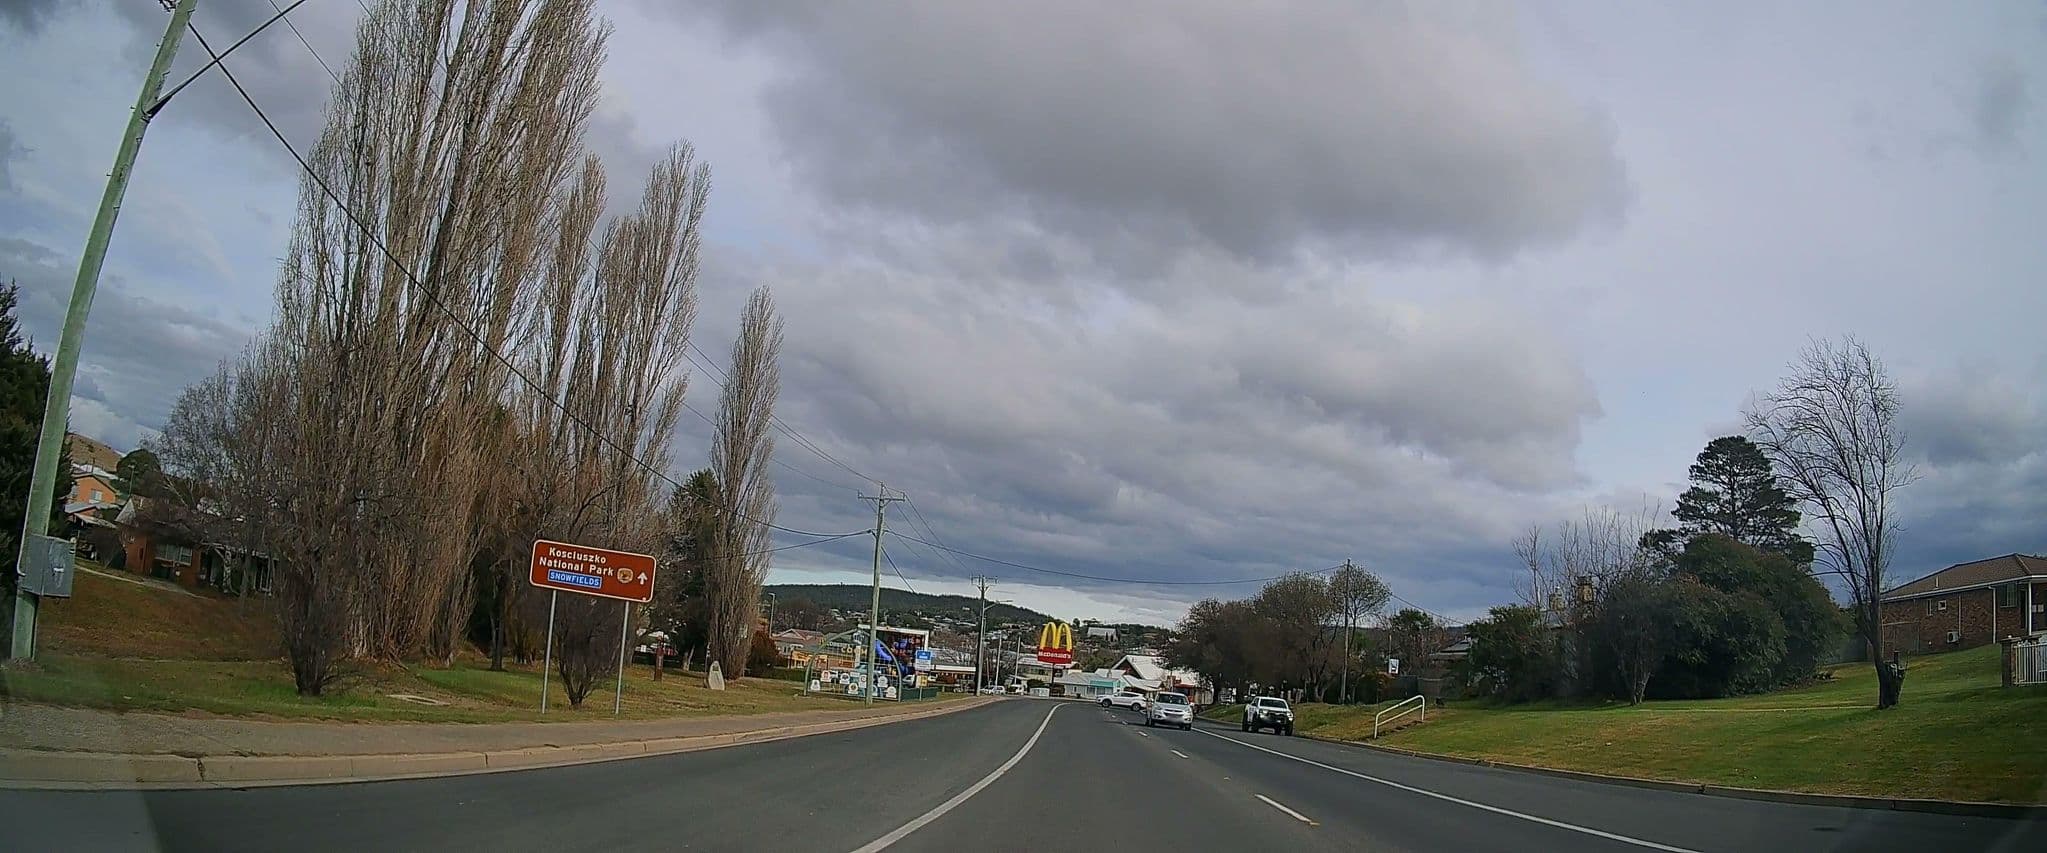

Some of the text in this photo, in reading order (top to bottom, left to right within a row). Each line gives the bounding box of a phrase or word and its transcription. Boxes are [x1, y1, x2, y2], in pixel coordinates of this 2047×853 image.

[549, 547, 606, 564] Kosciuszko
[539, 557, 614, 576] National Park
[550, 572, 600, 586] SNOWFIELDS
